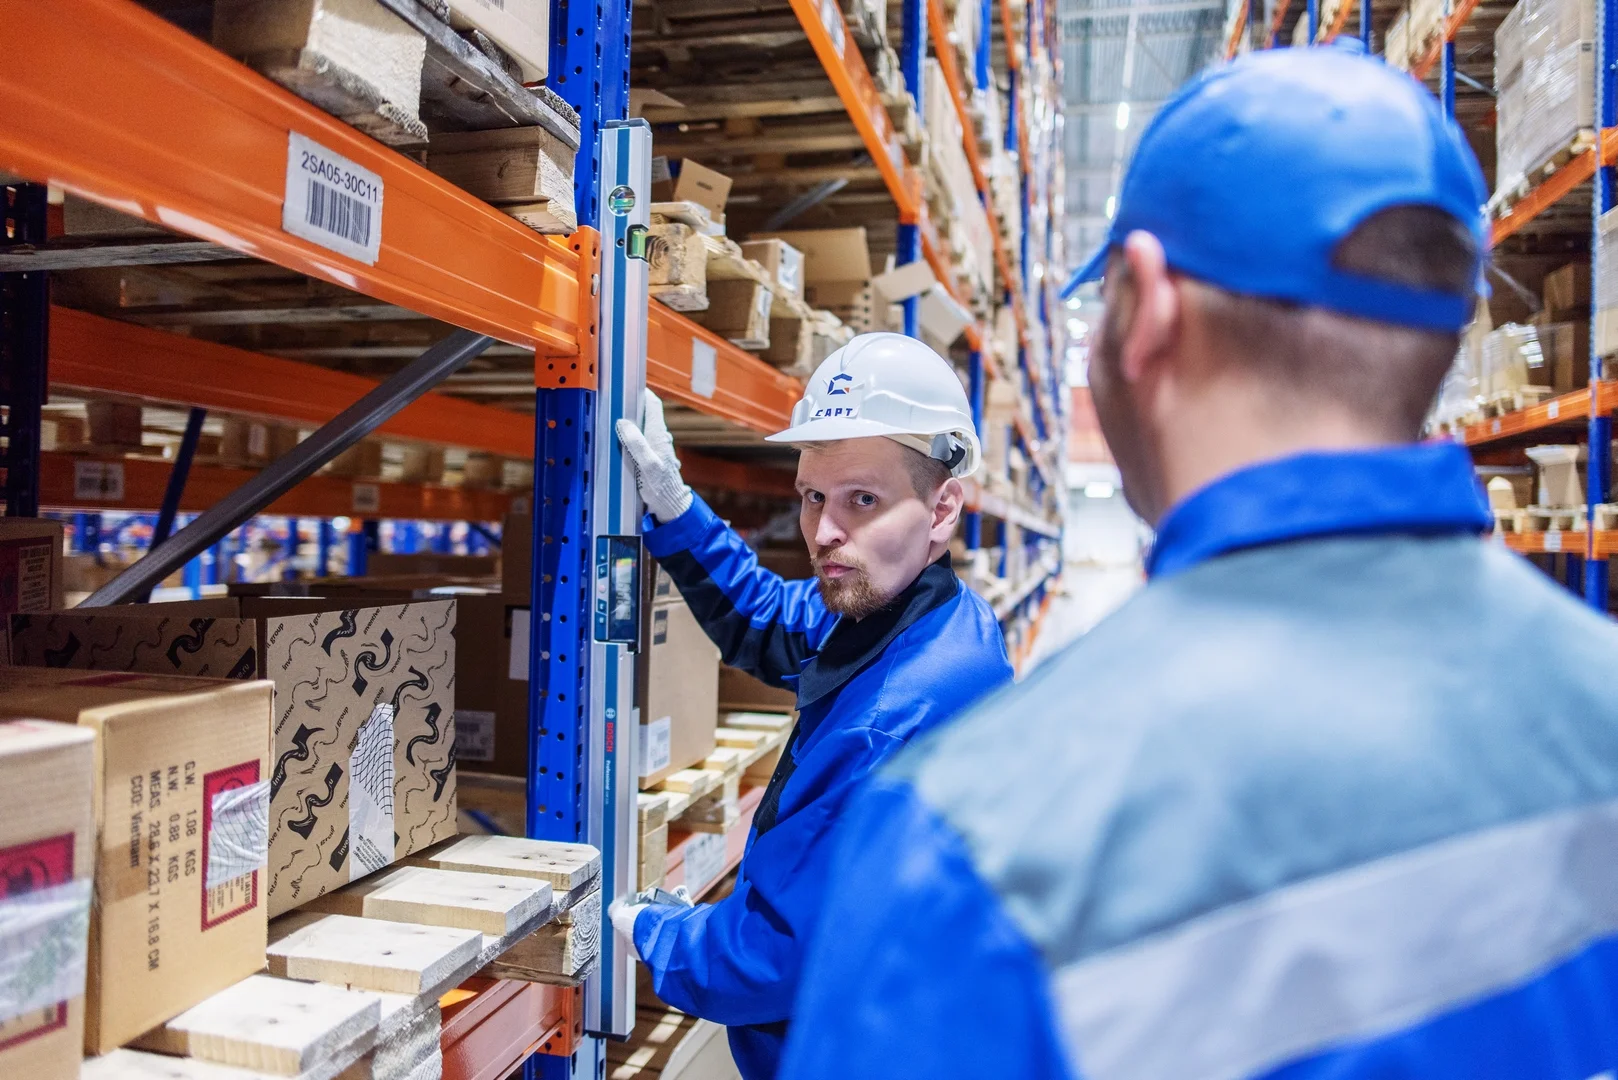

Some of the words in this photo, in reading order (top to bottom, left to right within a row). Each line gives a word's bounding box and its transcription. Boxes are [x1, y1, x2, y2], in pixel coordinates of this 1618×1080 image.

[301, 150, 378, 203] 2SA05-30C11
[270, 622, 284, 645] group
[275, 703, 295, 735] inventive
[336, 706, 349, 728] group
[606, 722, 614, 752] BOSCH
[168, 814, 180, 843] 0.88
[186, 809, 197, 837] 1.08
[130, 811, 143, 868] Vietnam
[167, 856, 180, 883] KGS
[184, 849, 196, 877] KGS
[148, 917, 160, 946] 16.8
[148, 949, 159, 972] CM
